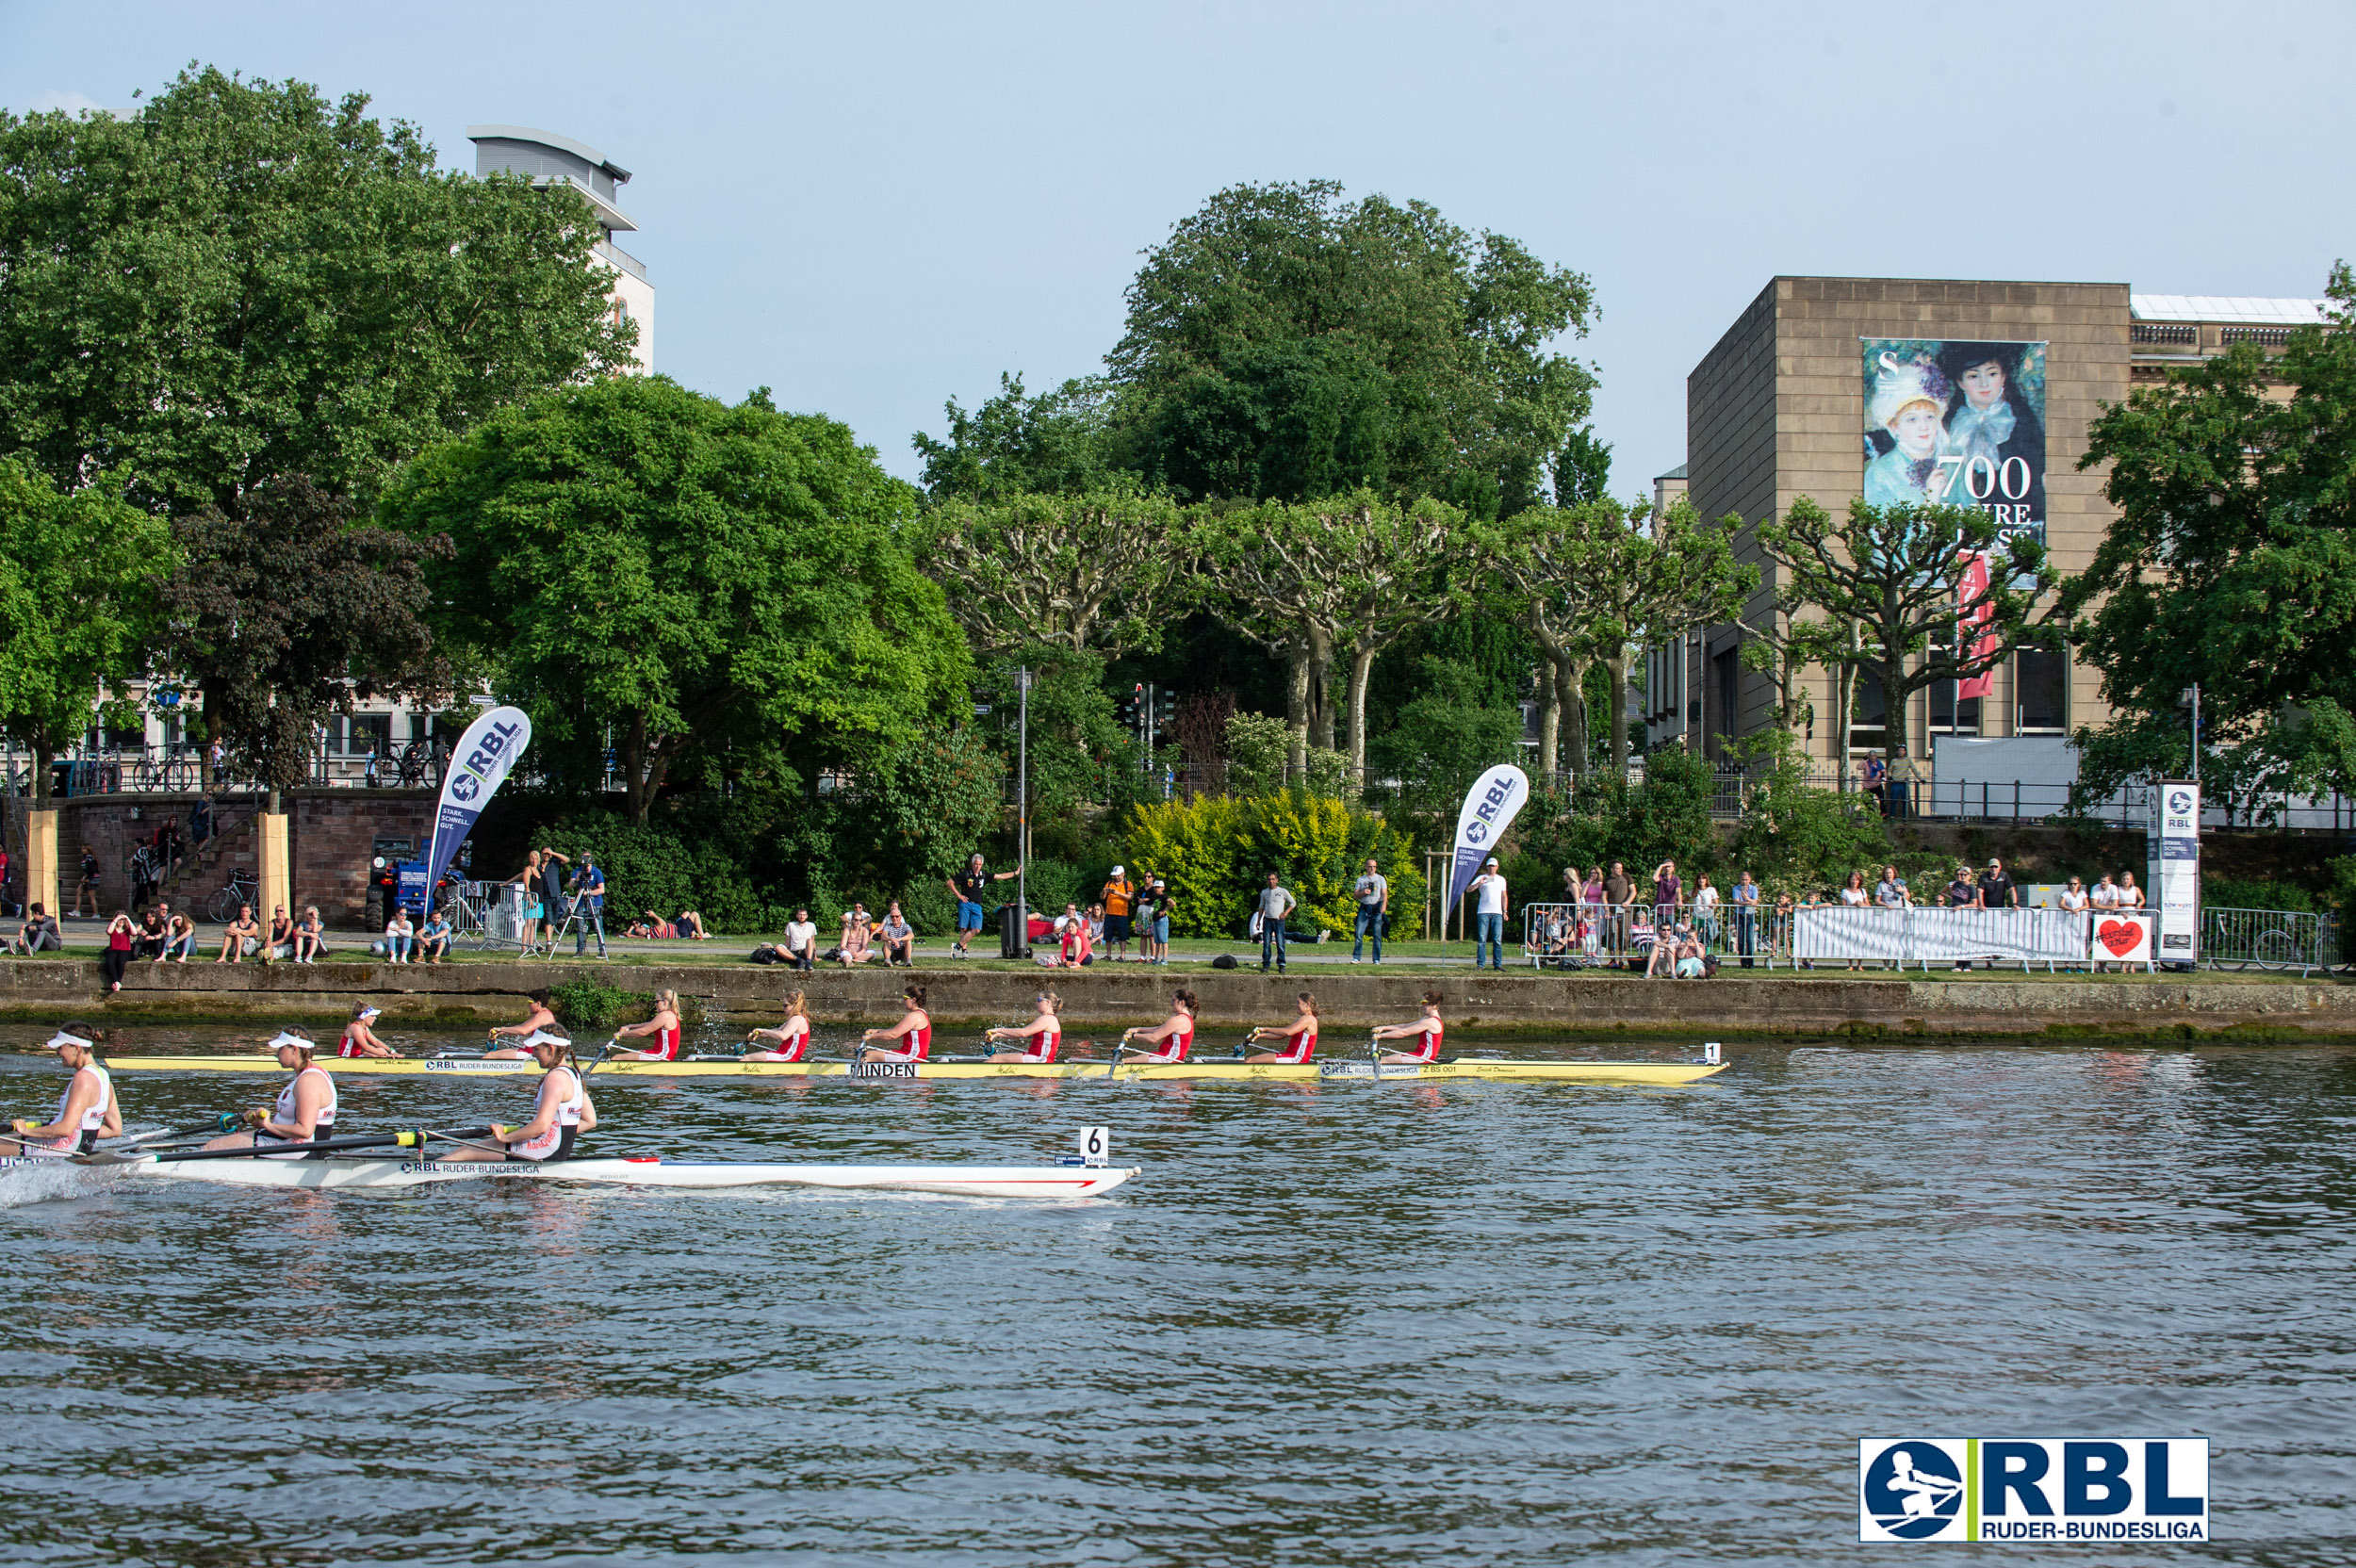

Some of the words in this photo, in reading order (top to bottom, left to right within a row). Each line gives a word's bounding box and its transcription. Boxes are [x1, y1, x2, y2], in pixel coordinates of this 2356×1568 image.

[1937, 455, 2031, 499] 700
[466, 721, 518, 776] RBL
[484, 727, 523, 779] RUDER-BUNDESLIGA
[1475, 777, 1513, 822] RBL
[442, 808, 464, 817] STARK.
[440, 822, 454, 830] GUT.
[441, 815, 470, 825] SCHNELL.
[2168, 819, 2191, 827] RBL
[1708, 1045, 1714, 1057] 1
[850, 1064, 916, 1077] MINDEN
[1088, 1128, 1101, 1154] 6
[414, 1162, 440, 1172] RBL
[443, 1164, 540, 1173] RUDER-BUNDESLIGA
